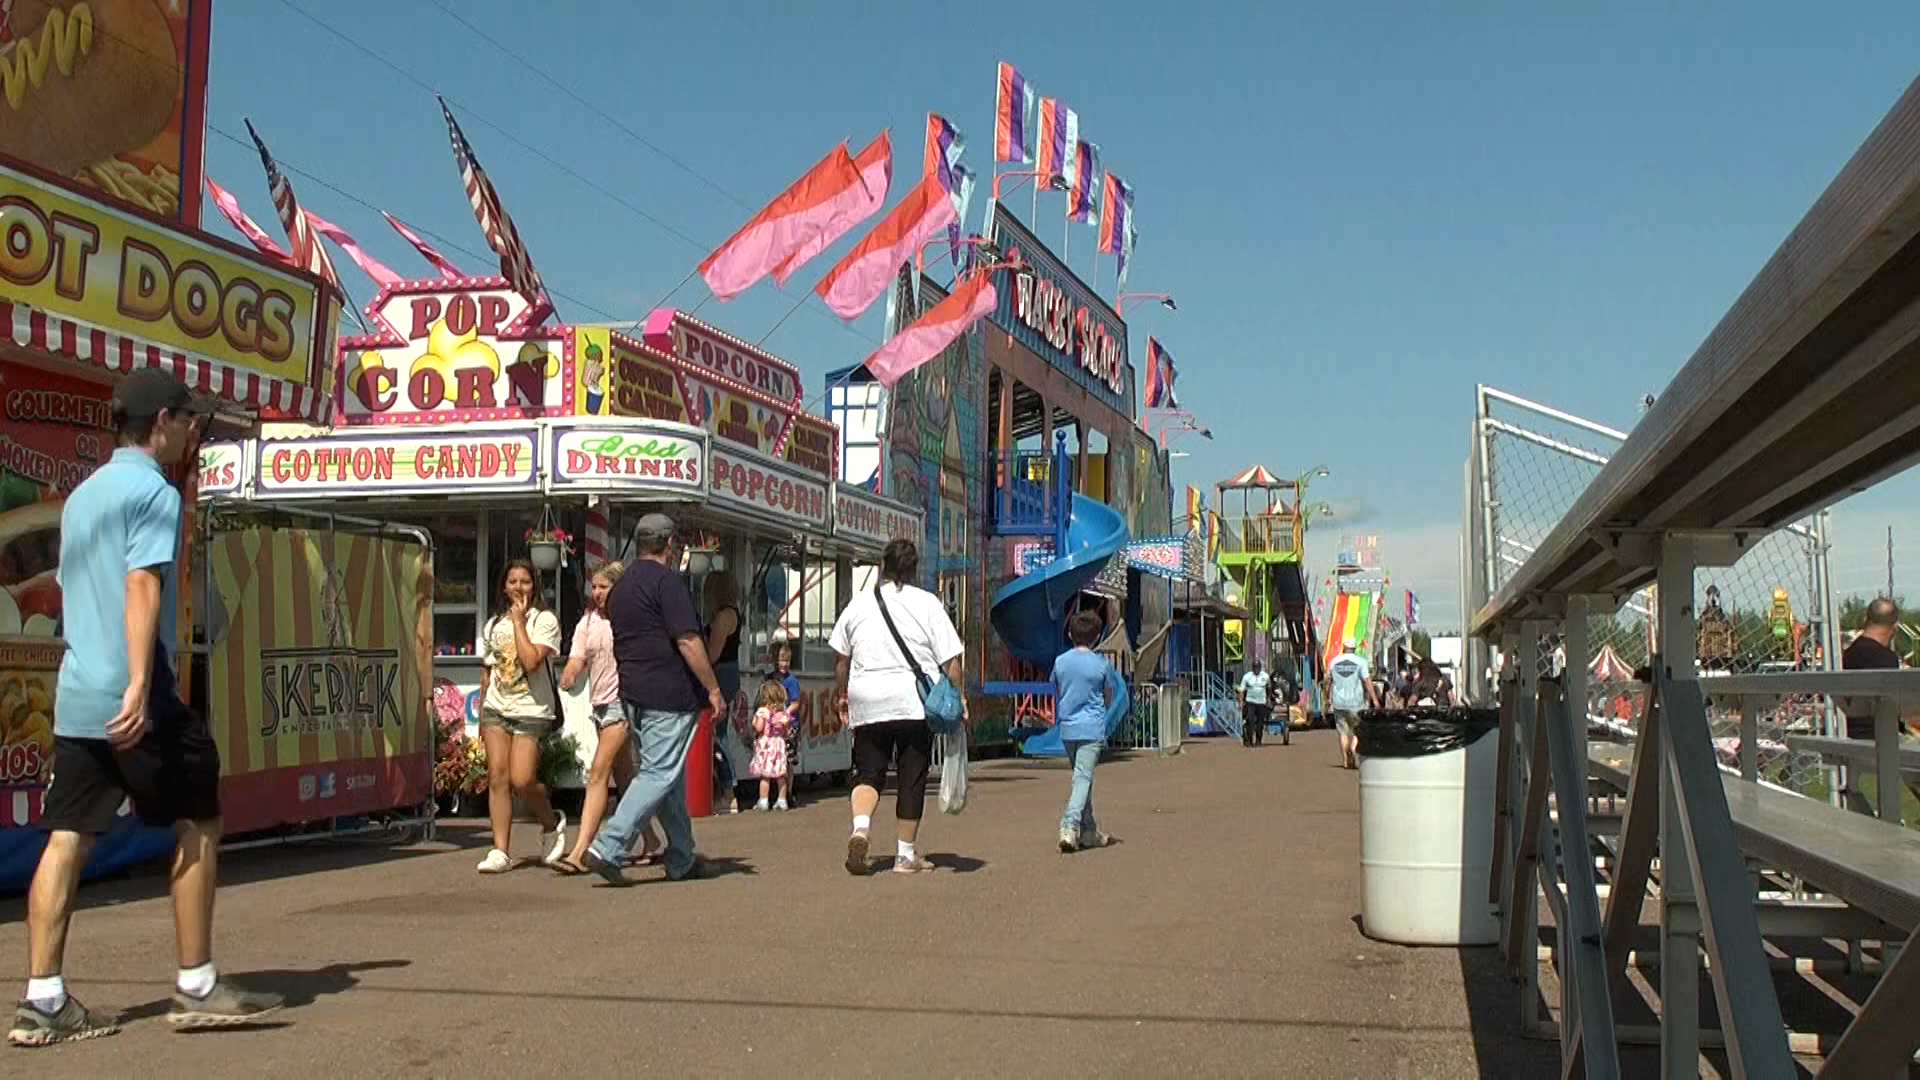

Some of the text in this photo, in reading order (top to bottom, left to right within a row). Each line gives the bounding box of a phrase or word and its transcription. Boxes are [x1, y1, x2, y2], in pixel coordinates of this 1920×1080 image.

[117, 236, 296, 362] DOGS
[409, 294, 511, 341] POP
[356, 354, 550, 412] CORN
[685, 331, 784, 398] POPCORN
[5, 389, 101, 426] GOURMET
[75, 433, 99, 459] OR
[272, 443, 521, 484] COTTON CANDY
[566, 449, 698, 482] DRINKS
[582, 435, 689, 458] Cold
[712, 455, 824, 521] POPCORN
[839, 497, 881, 536] COTTON
